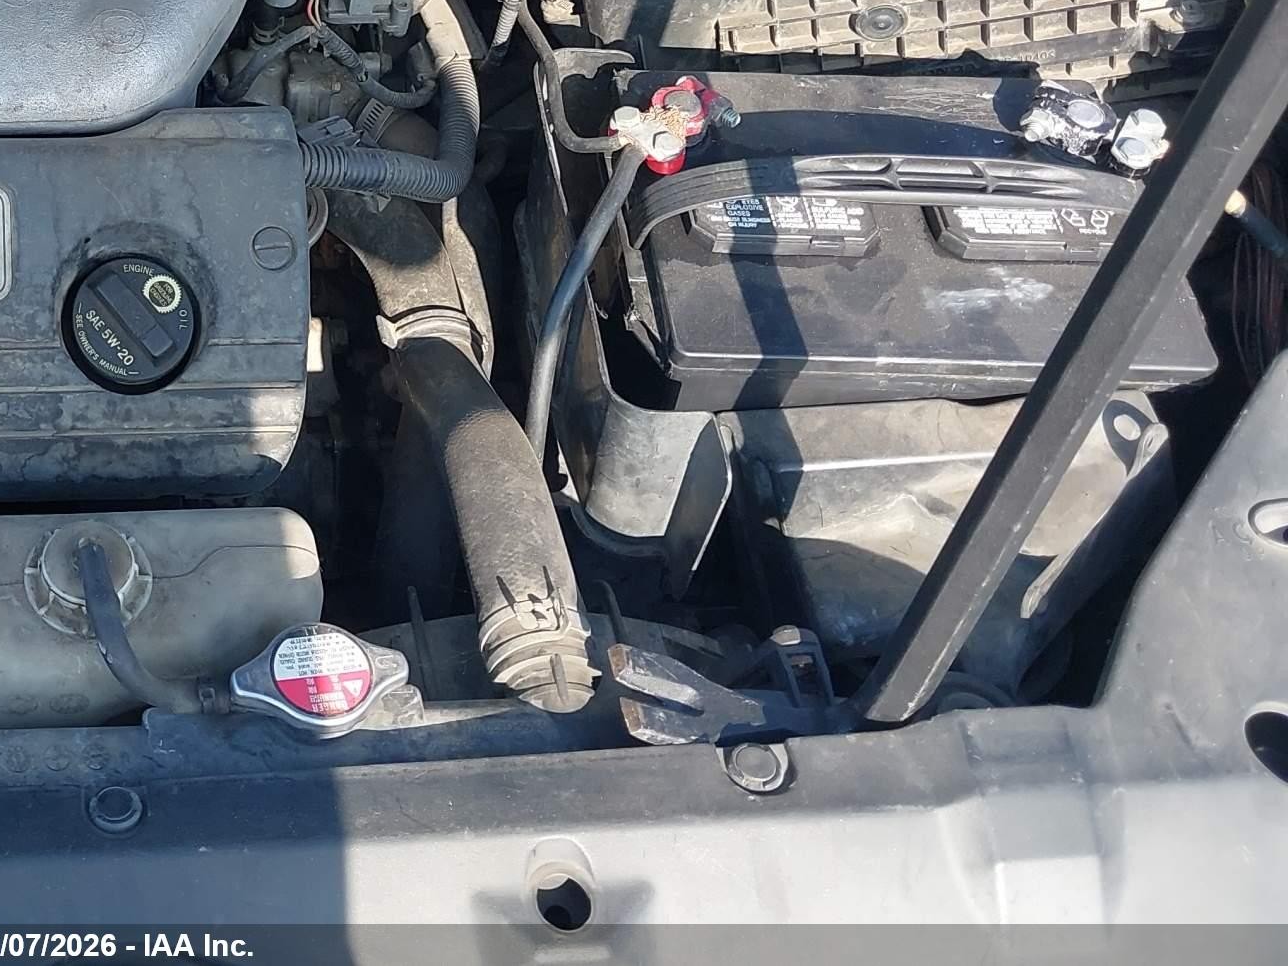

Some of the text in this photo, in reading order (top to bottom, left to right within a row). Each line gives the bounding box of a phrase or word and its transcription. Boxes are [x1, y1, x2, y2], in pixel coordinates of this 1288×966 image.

[123, 264, 155, 276] ENGINE
[178, 309, 188, 331] OIL
[78, 330, 100, 361] OWNER'S
[99, 359, 128, 376] MANUAL
[85, 310, 134, 366] SAE 5W-20
